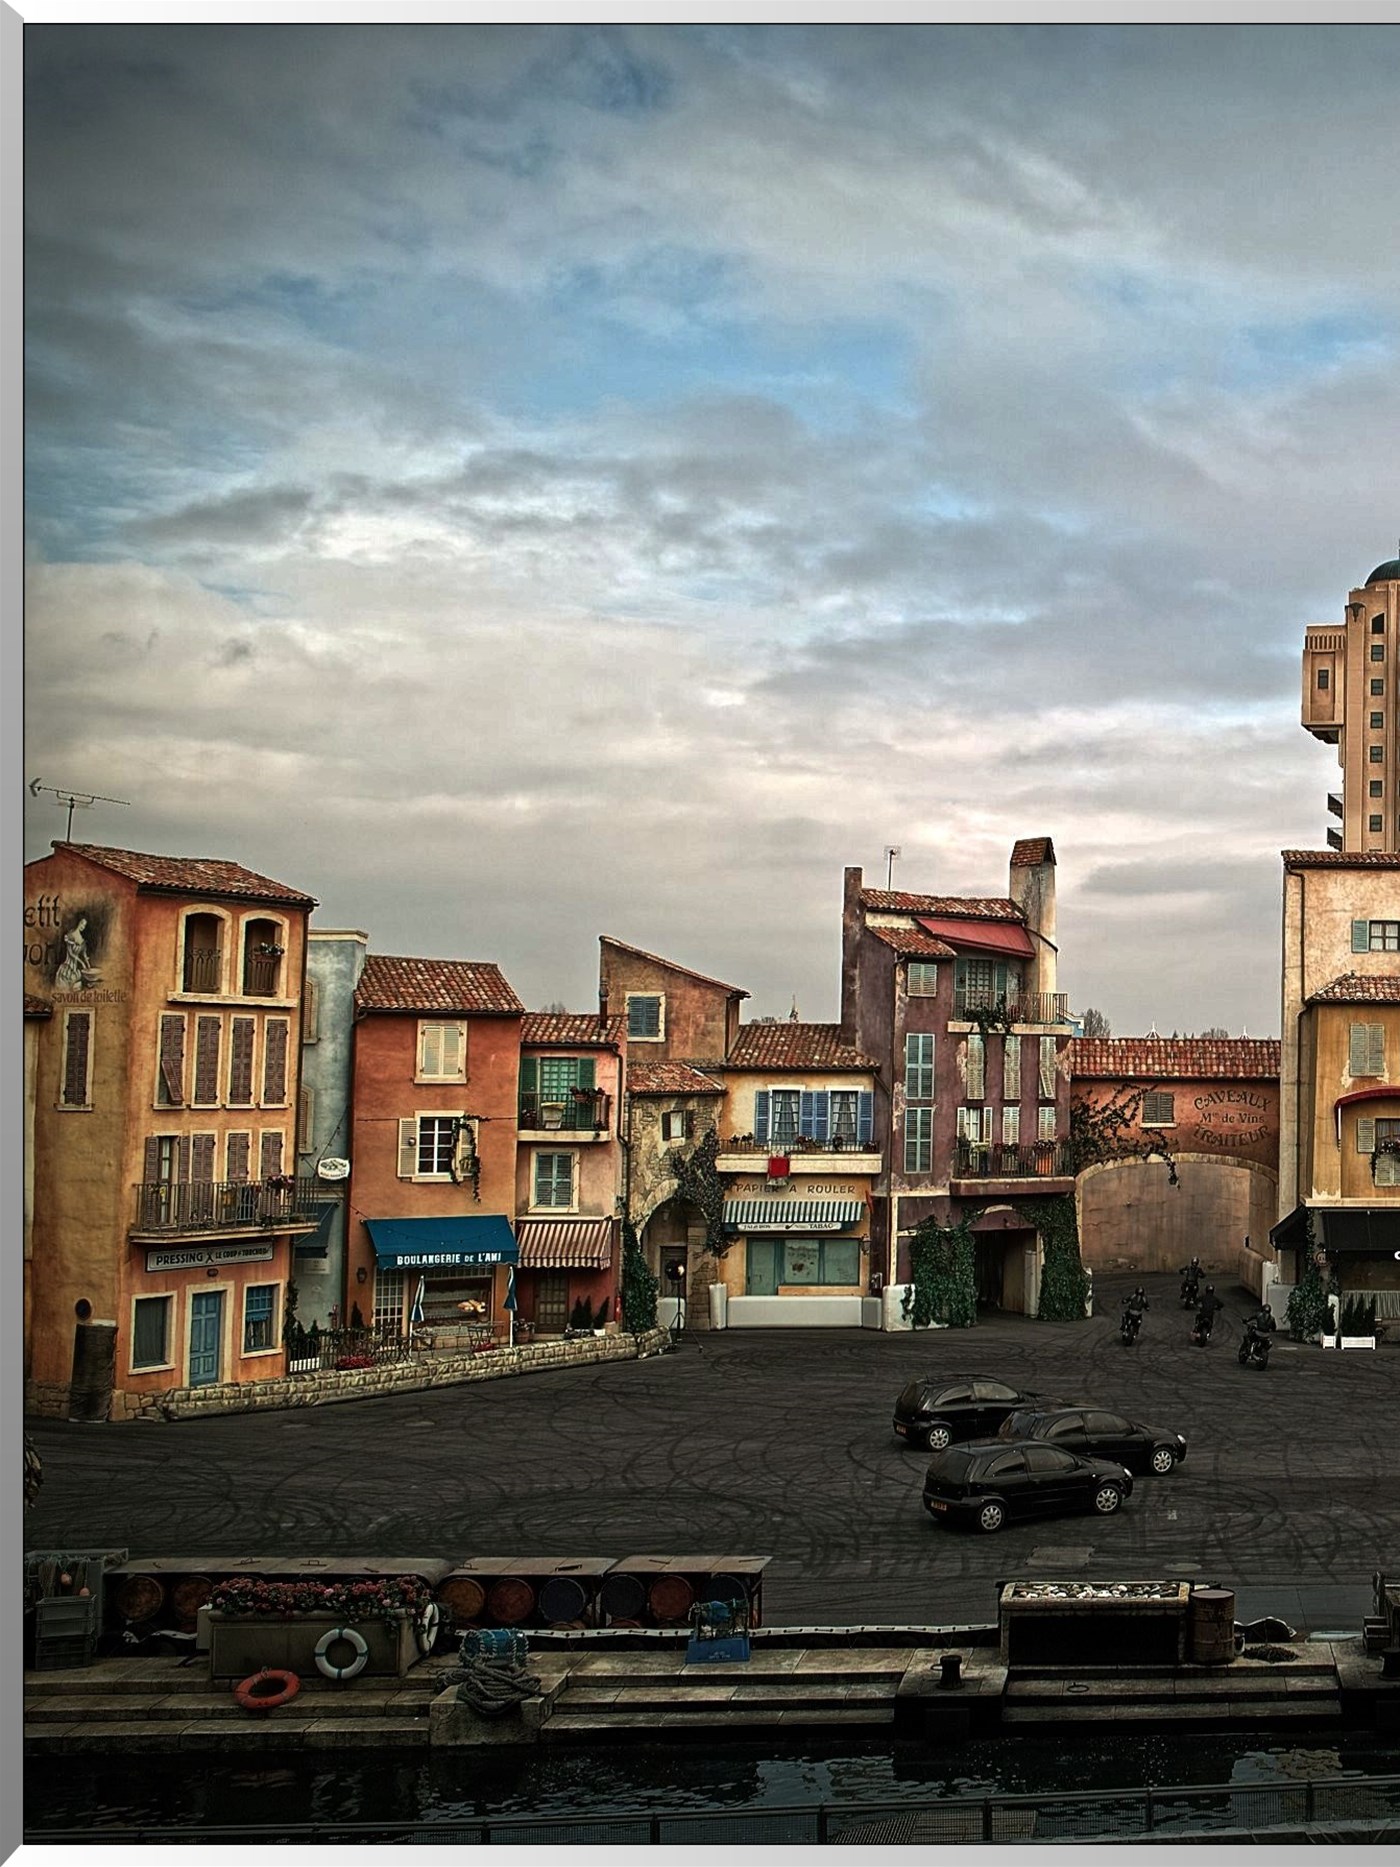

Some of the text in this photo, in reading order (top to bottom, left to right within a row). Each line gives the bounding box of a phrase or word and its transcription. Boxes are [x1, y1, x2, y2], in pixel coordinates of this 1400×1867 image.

[52, 989, 127, 1004] savon de toilette
[1194, 1089, 1272, 1112] CAVEAUX
[1221, 1112, 1235, 1124] de
[1239, 1113, 1265, 1124] Vins
[1193, 1123, 1272, 1147] TRAITEUR
[736, 1183, 856, 1194] PAPIER A ROULER
[156, 1252, 203, 1265] PRESSING
[396, 1253, 461, 1266] BOULANGERIE
[478, 1252, 502, 1262] L'AMI
